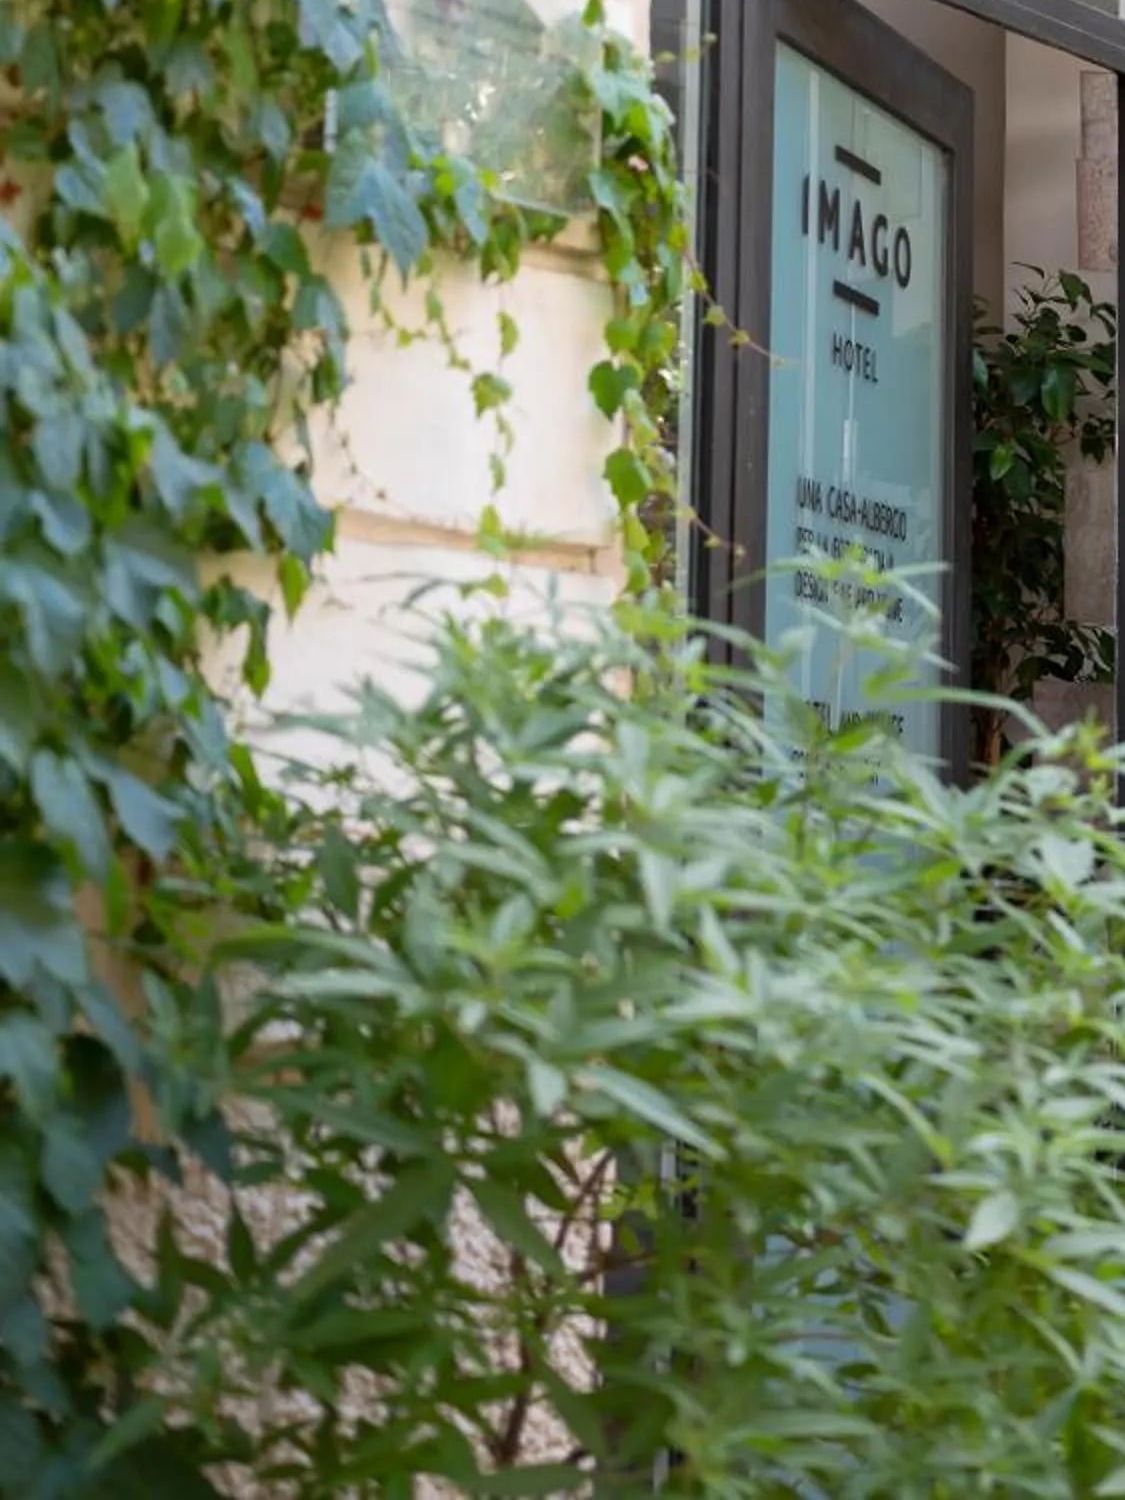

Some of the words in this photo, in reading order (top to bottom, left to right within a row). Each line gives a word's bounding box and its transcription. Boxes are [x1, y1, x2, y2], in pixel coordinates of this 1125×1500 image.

[801, 174, 911, 289] IMAGO
[832, 331, 879, 383] HOTEL
[796, 474, 822, 513] UNA
[826, 485, 907, 542] CASA-ALBERGO
